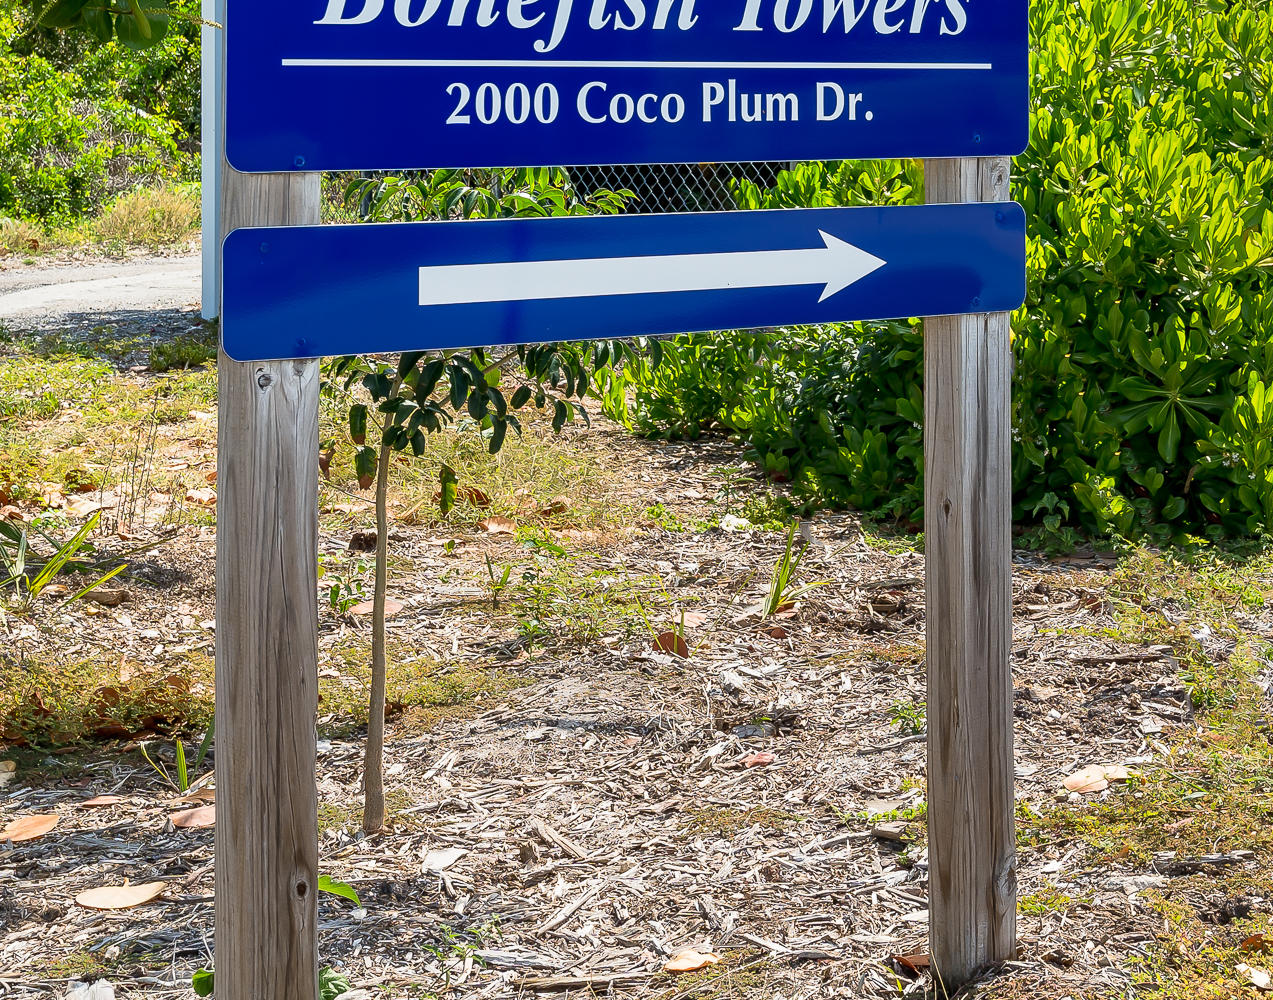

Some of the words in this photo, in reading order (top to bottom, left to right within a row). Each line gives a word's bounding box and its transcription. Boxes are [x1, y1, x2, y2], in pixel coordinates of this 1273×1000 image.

[445, 82, 560, 125] 2000
[576, 81, 685, 124] Coco
[702, 78, 799, 123] Plum
[816, 81, 874, 121] Dr.
